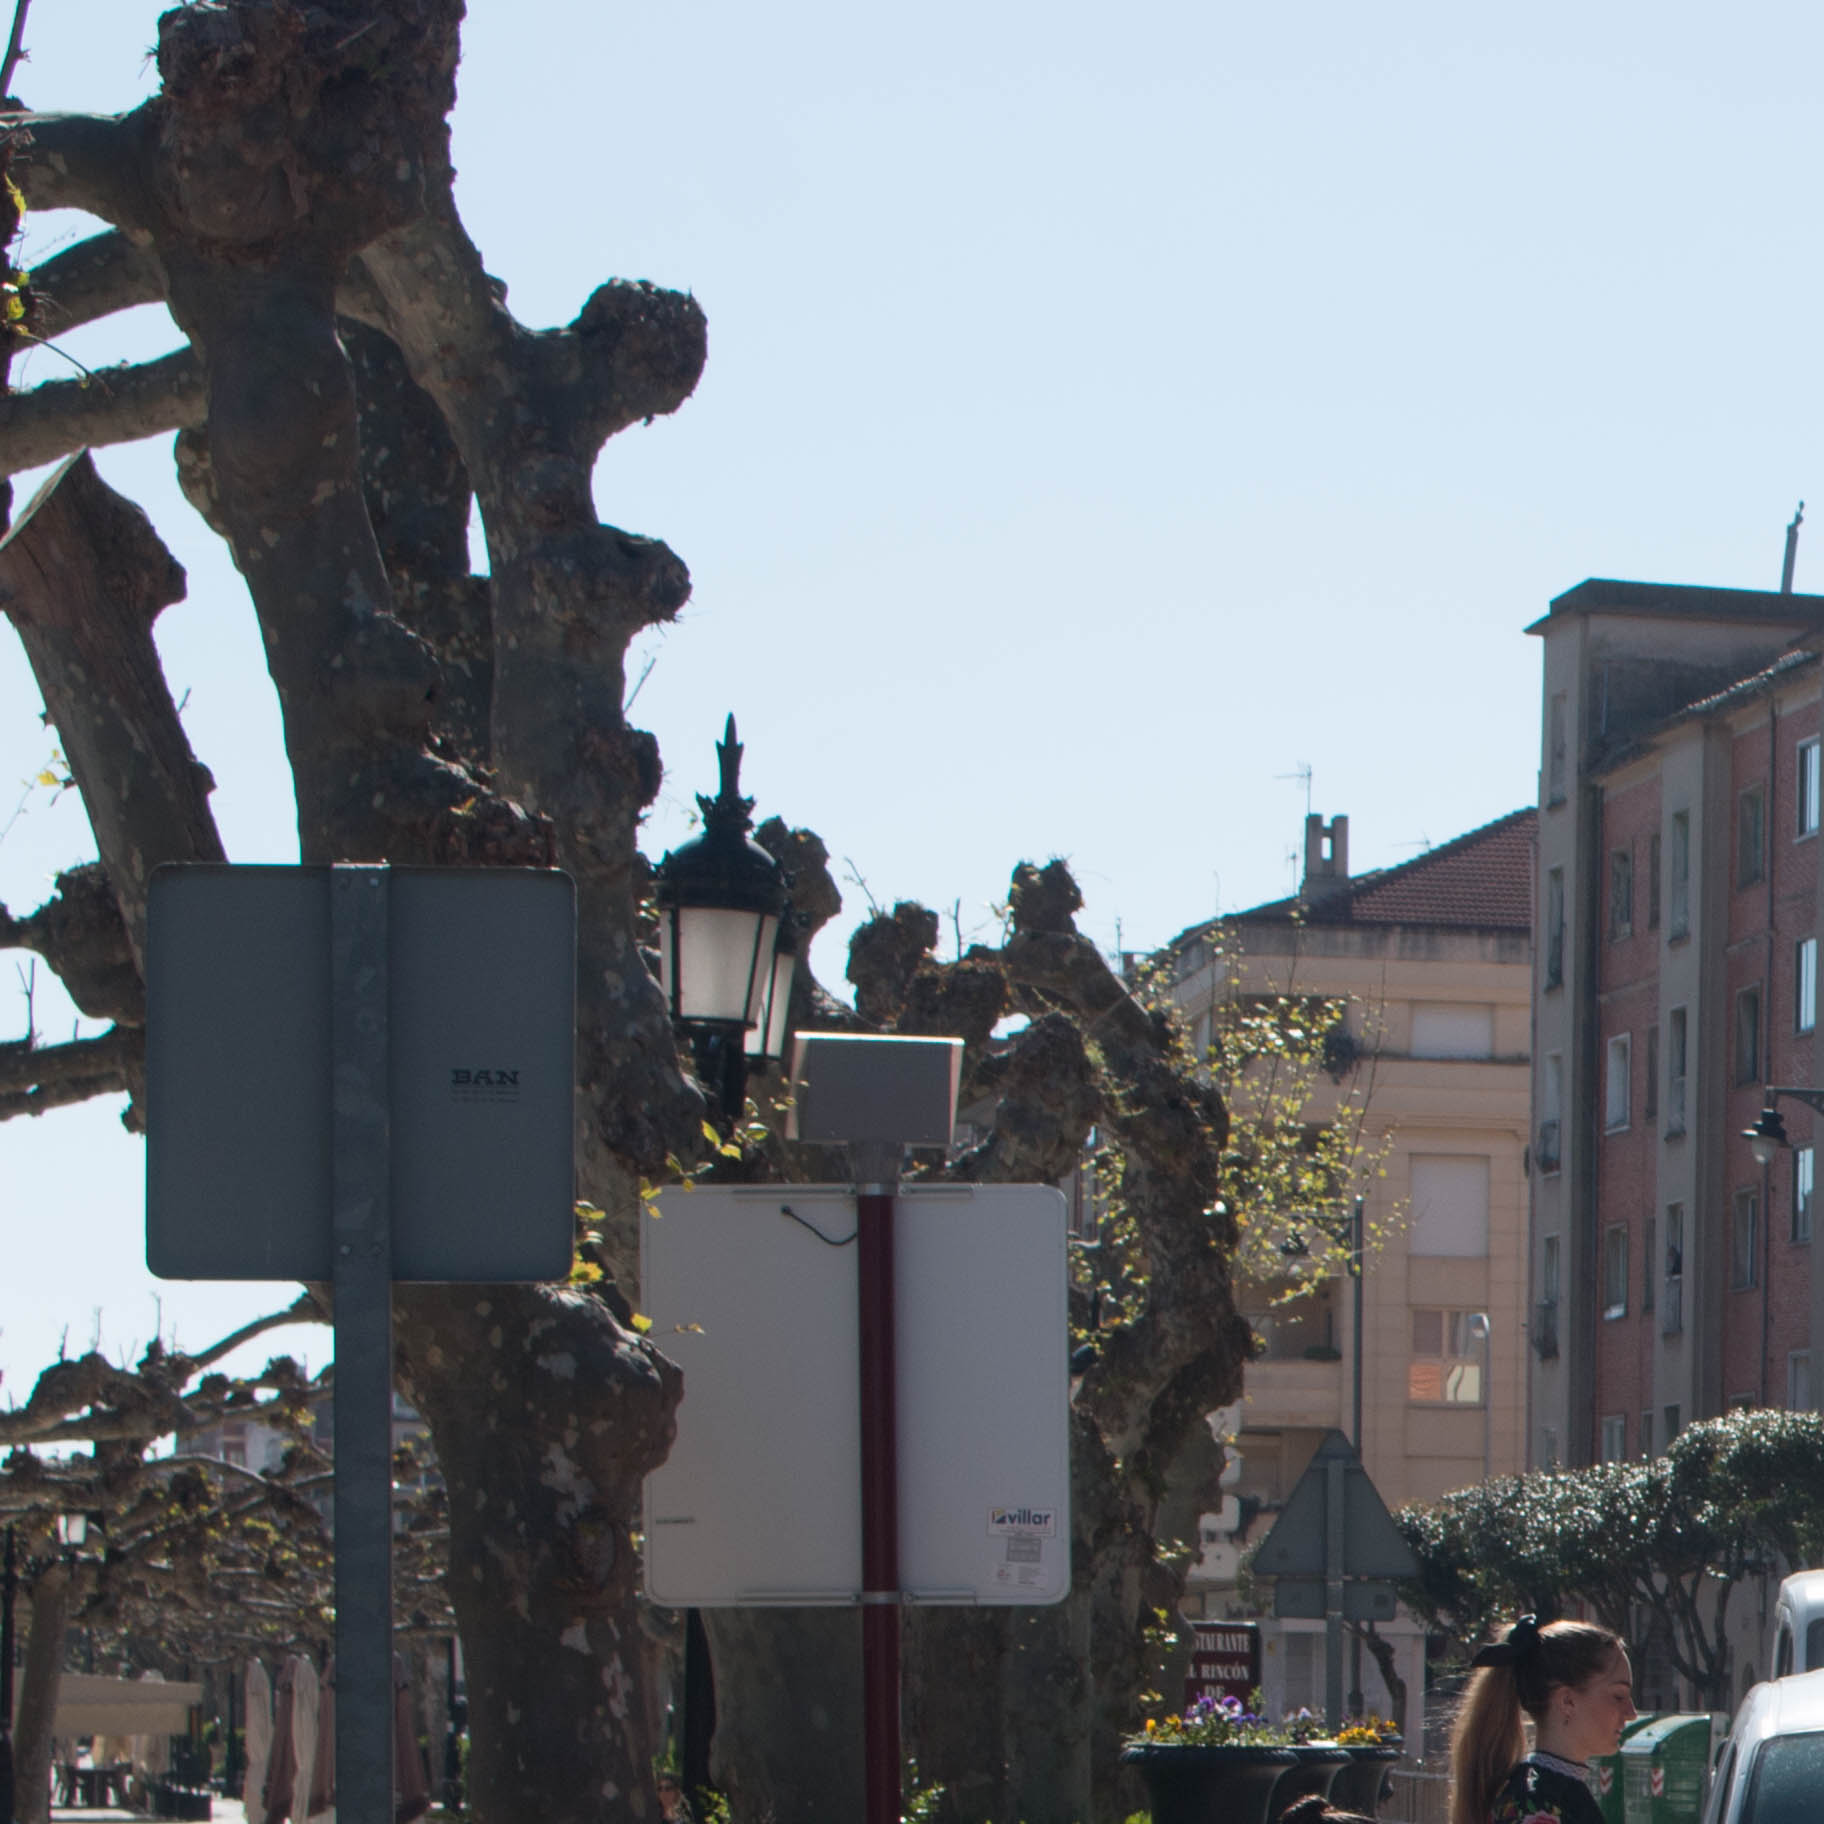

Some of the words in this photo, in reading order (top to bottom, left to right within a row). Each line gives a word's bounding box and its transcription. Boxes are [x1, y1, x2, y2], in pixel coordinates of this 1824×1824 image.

[451, 1069, 520, 1085] BAN
[1007, 1509, 1051, 1525] villar
[1200, 1660, 1249, 1681] RINCÓN
